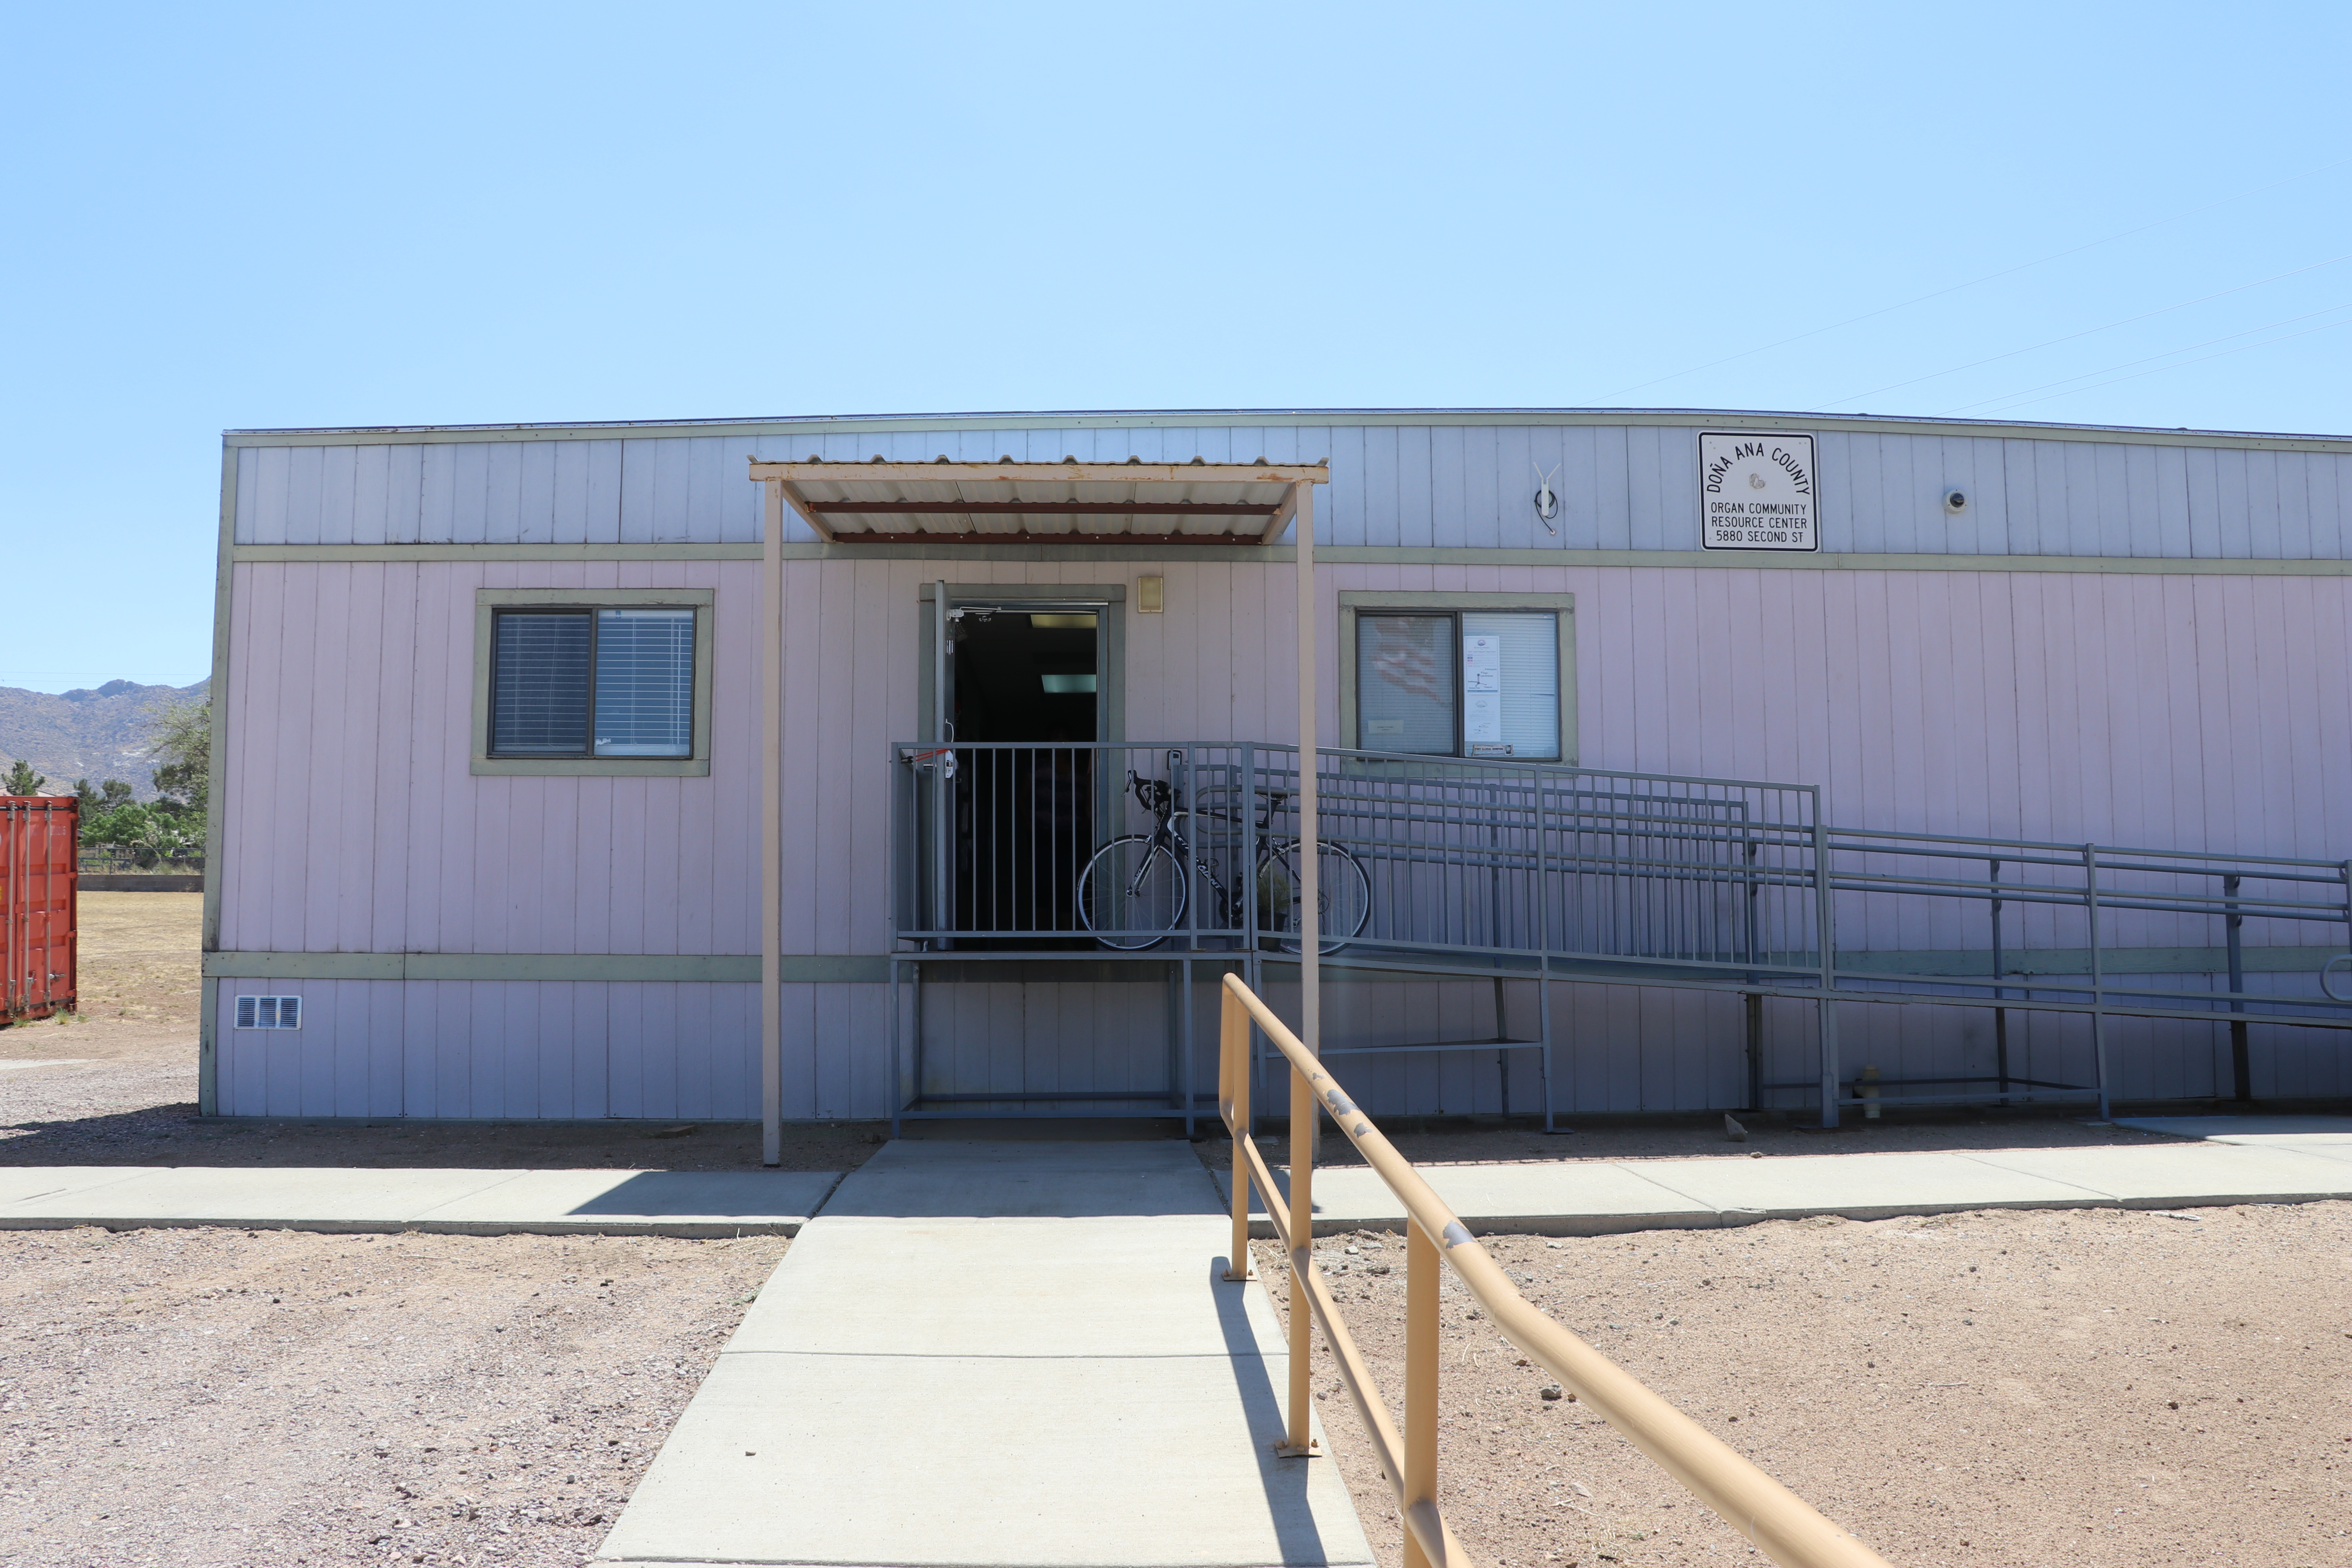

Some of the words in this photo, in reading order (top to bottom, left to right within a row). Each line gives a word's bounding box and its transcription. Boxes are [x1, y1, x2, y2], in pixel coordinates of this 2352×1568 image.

[1707, 456, 1733, 493] DOÑA
[1735, 442, 1764, 460] ANA
[1772, 448, 1810, 495] COUNTY
[1711, 502, 1744, 514] ORGAN
[1749, 503, 1807, 515] COMMUNITY
[1711, 516, 1764, 528] RESOURCE
[1769, 517, 1807, 529] CENTER
[1717, 530, 1742, 541] 5880
[1748, 531, 1787, 542] SECOND
[1792, 532, 1803, 543] ST
